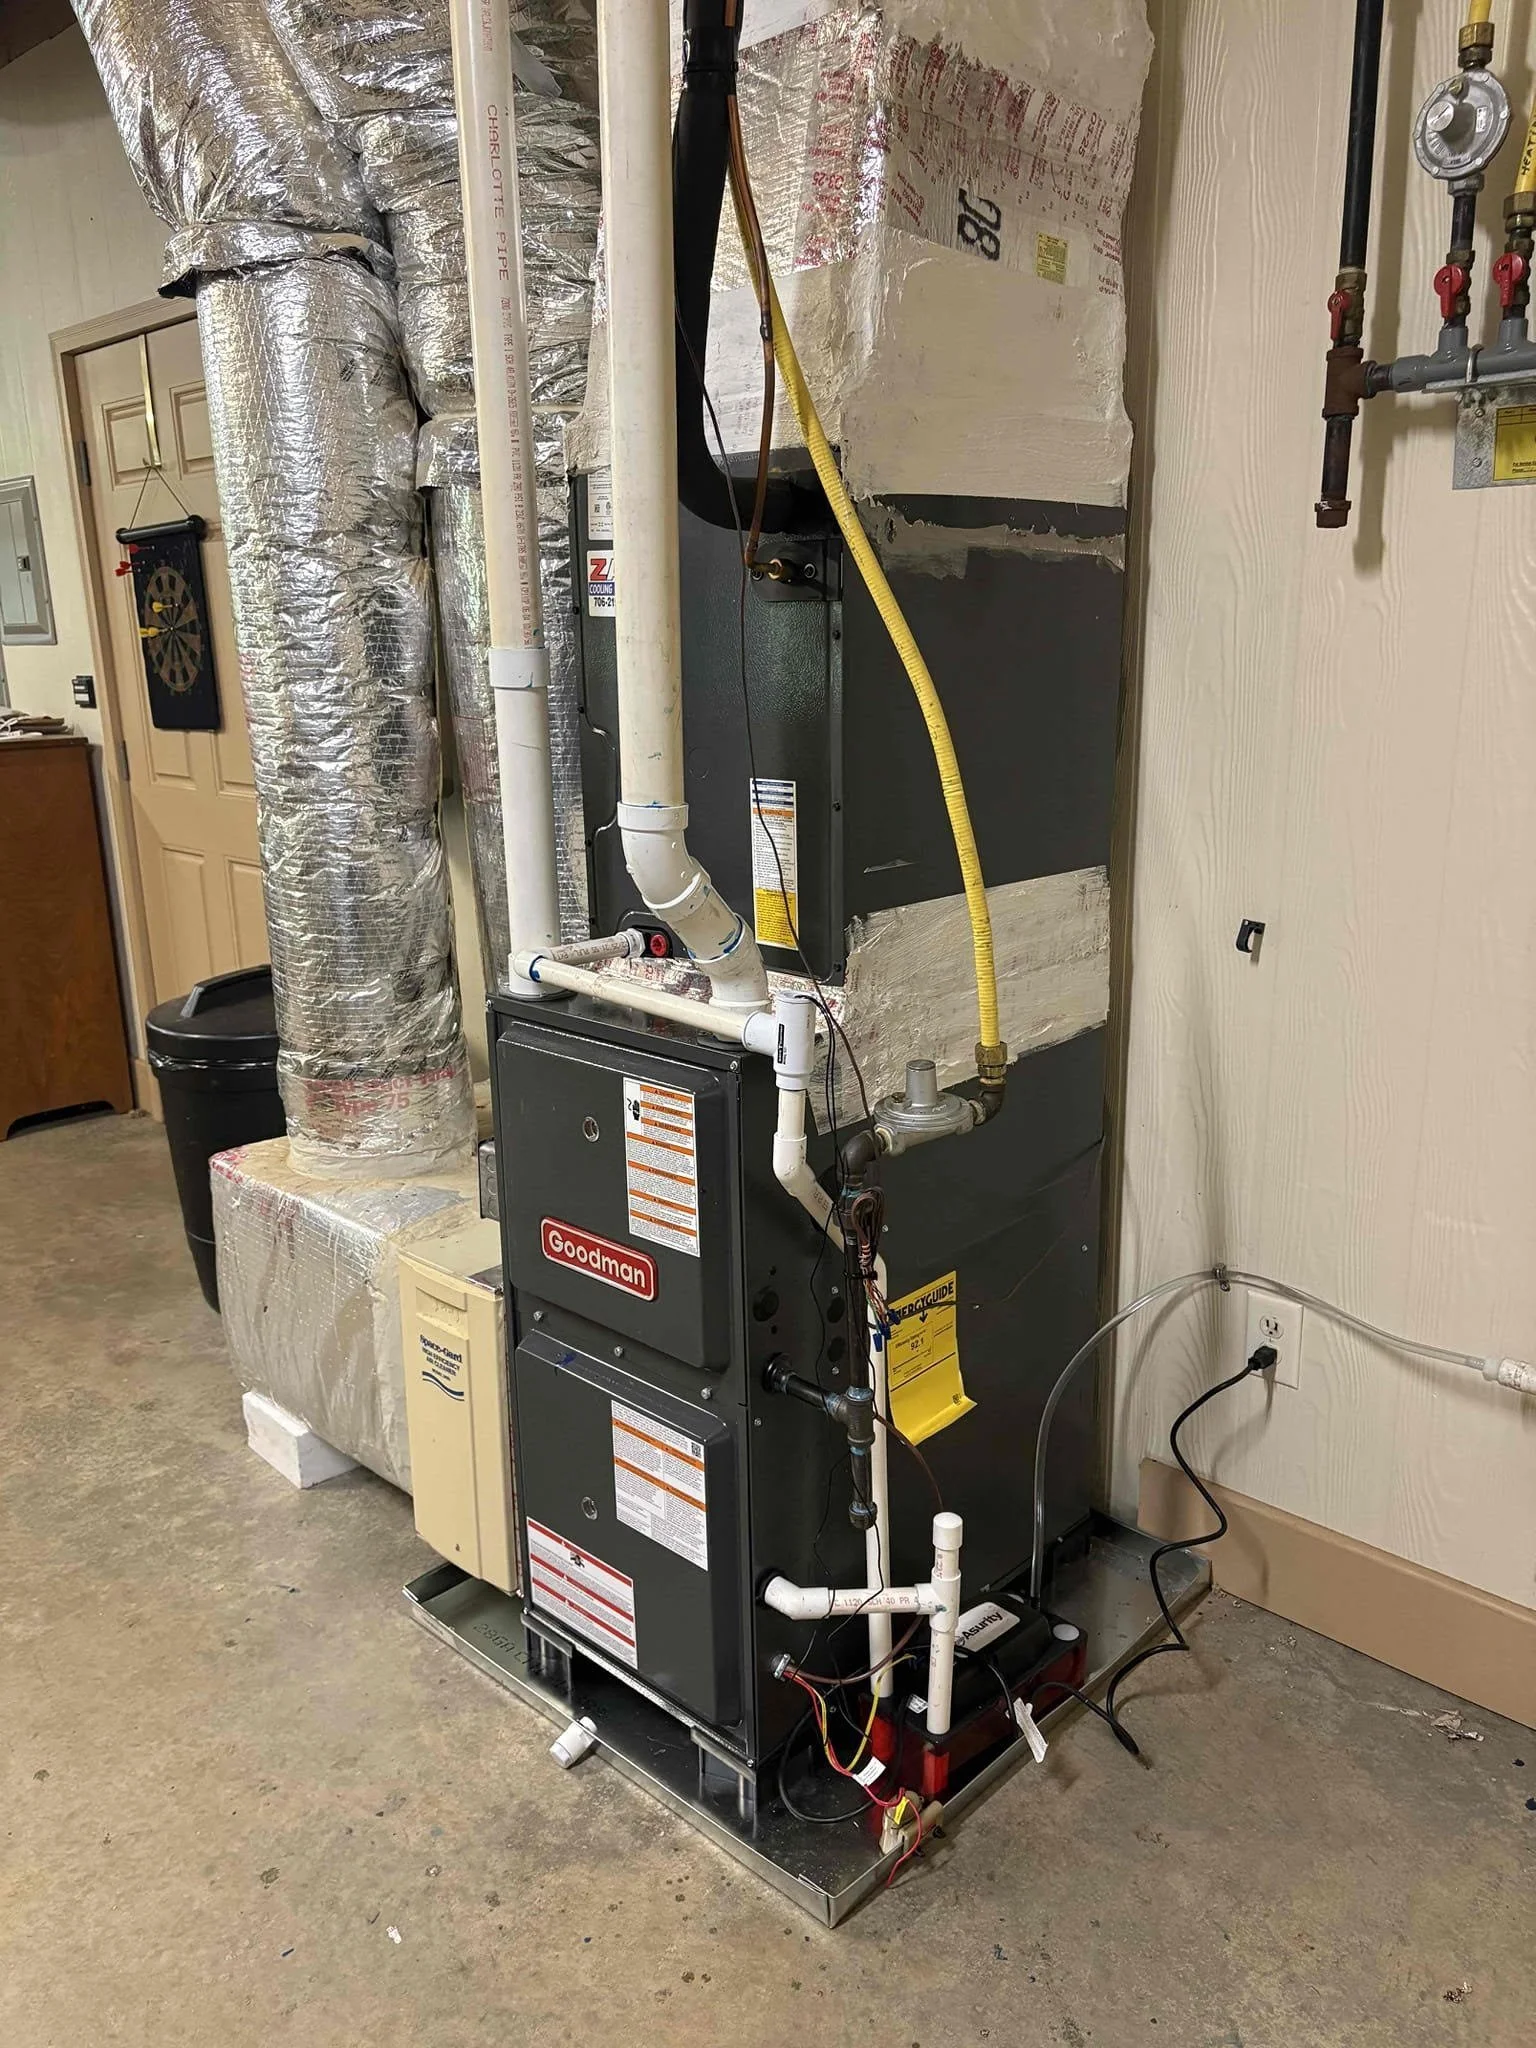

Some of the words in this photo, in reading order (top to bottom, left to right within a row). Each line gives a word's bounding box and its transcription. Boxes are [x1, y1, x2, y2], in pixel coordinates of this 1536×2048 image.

[487, 104, 504, 220] CHARLOTTE
[495, 230, 510, 282] PIPE
[589, 583, 613, 595] COOLING
[548, 1230, 646, 1289] Goodman
[911, 1337, 924, 1351] 92.1
[844, 1598, 863, 1607] 1120
[885, 1597, 895, 1605] 40
[899, 1596, 910, 1605] PR
[962, 1611, 1003, 1640] Asurity
